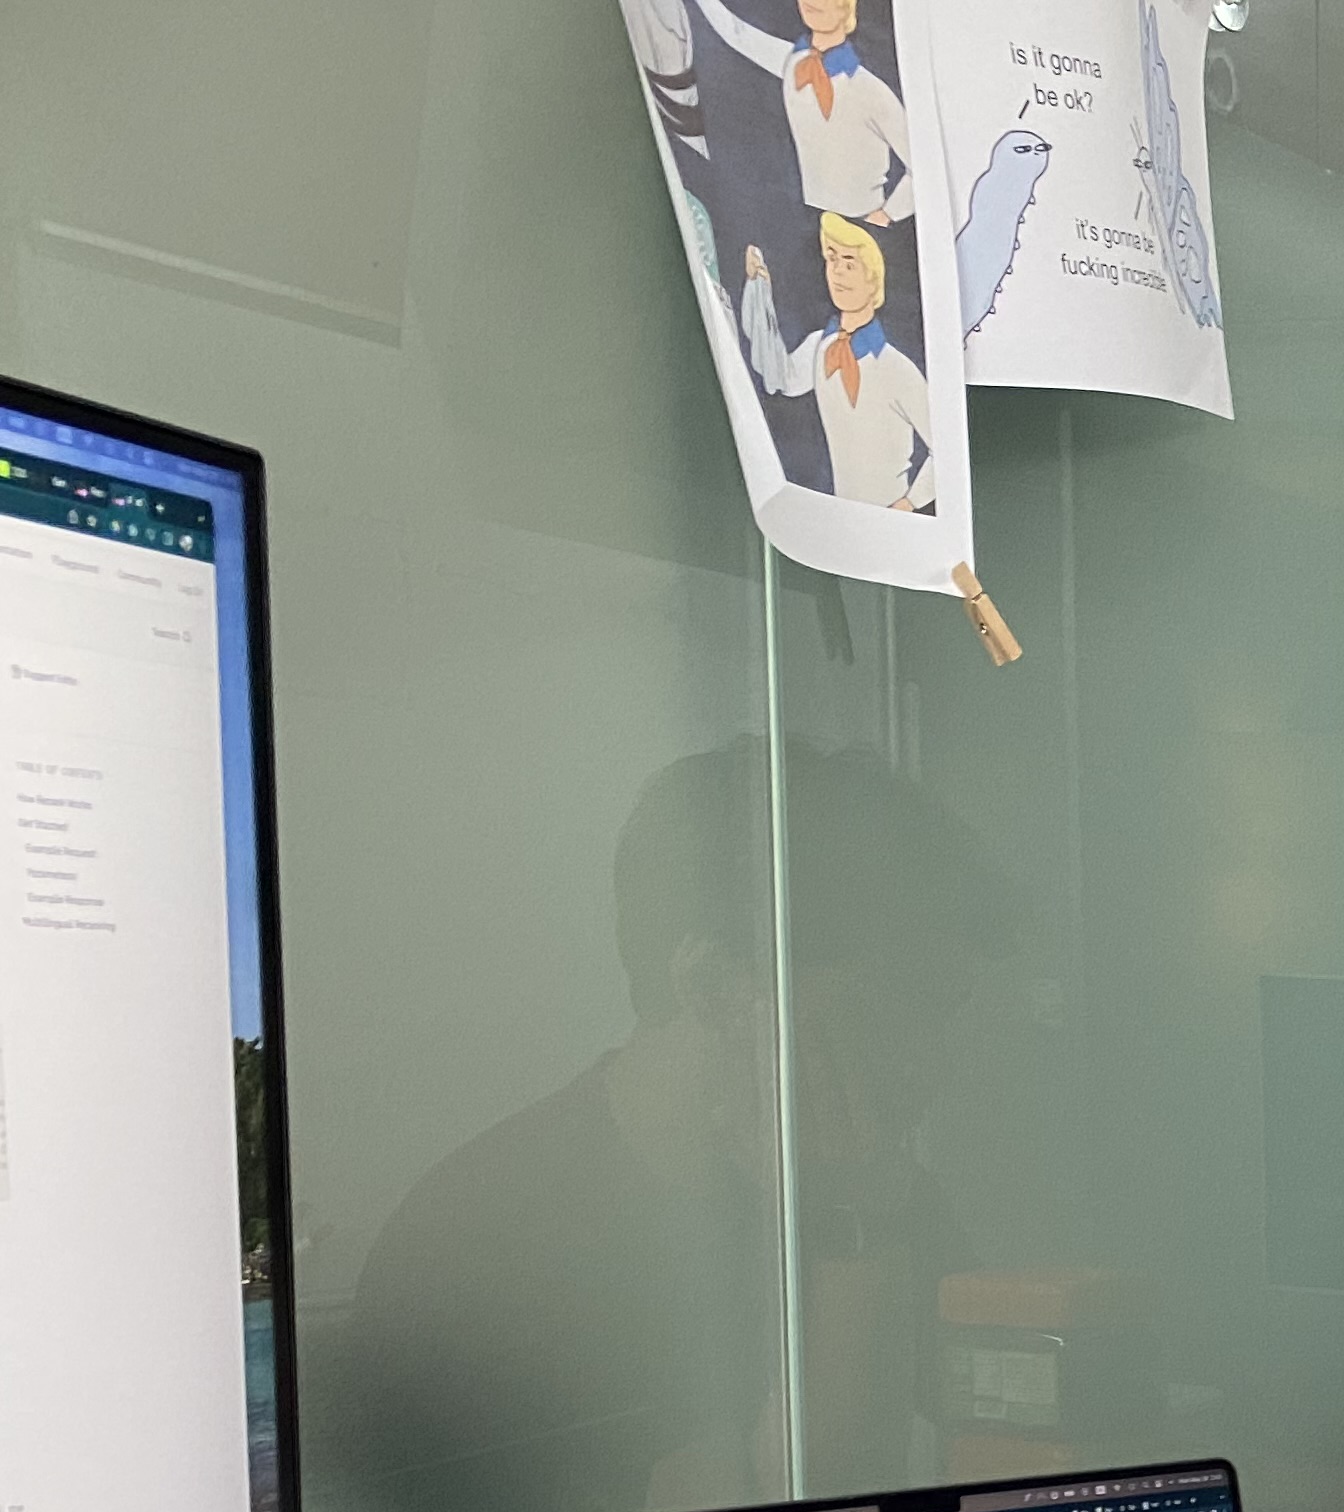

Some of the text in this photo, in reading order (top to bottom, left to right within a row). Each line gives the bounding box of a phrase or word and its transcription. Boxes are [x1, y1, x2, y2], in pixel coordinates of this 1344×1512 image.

[1008, 41, 1103, 80] is it gonna
[1033, 83, 1094, 114] be ok?
[1074, 218, 1099, 242] it's
[1102, 226, 1143, 253] gonna
[1060, 252, 1119, 286] fucking
